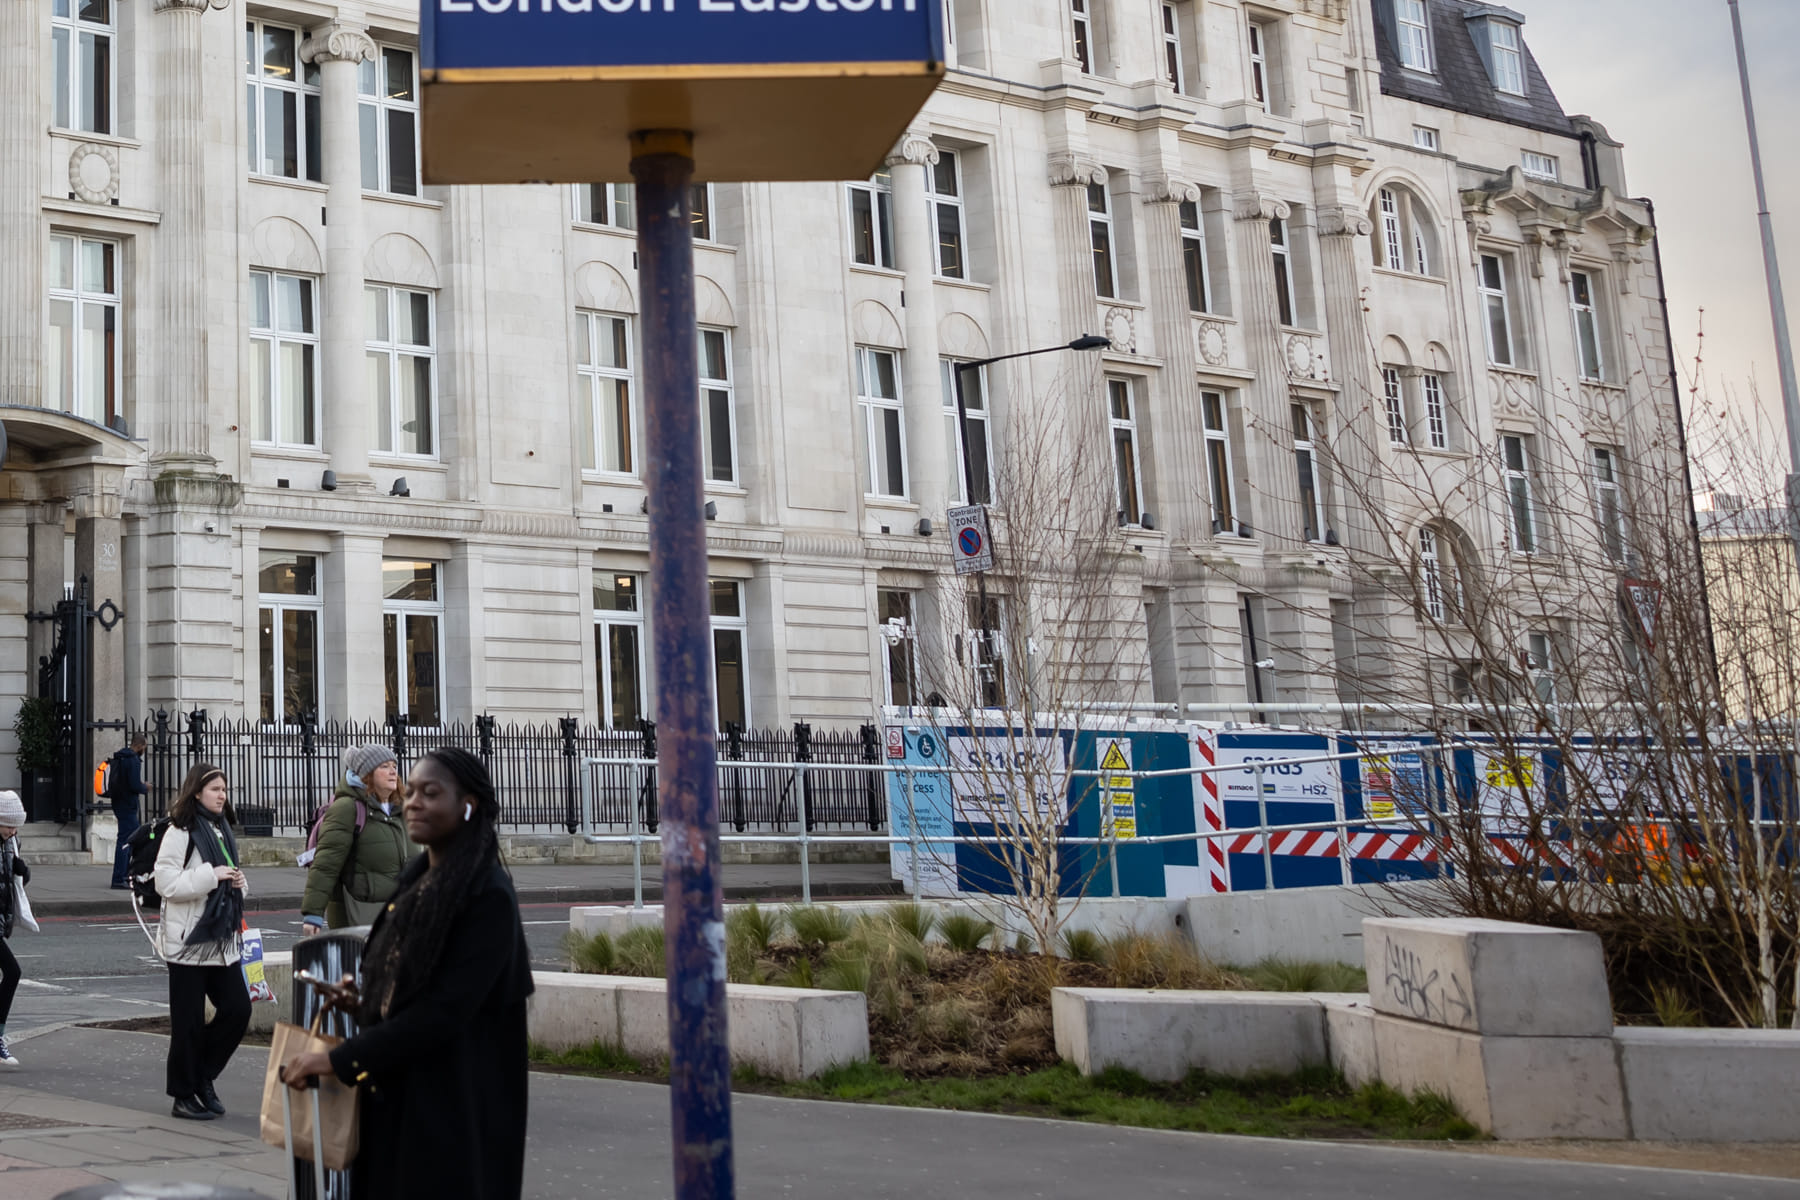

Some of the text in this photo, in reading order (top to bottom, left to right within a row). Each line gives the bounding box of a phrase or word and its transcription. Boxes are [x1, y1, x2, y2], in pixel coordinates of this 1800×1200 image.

[956, 515, 977, 527] ZONE
[101, 543, 115, 557] 30
[903, 784, 934, 793] acess
[1302, 784, 1328, 796] HS2
